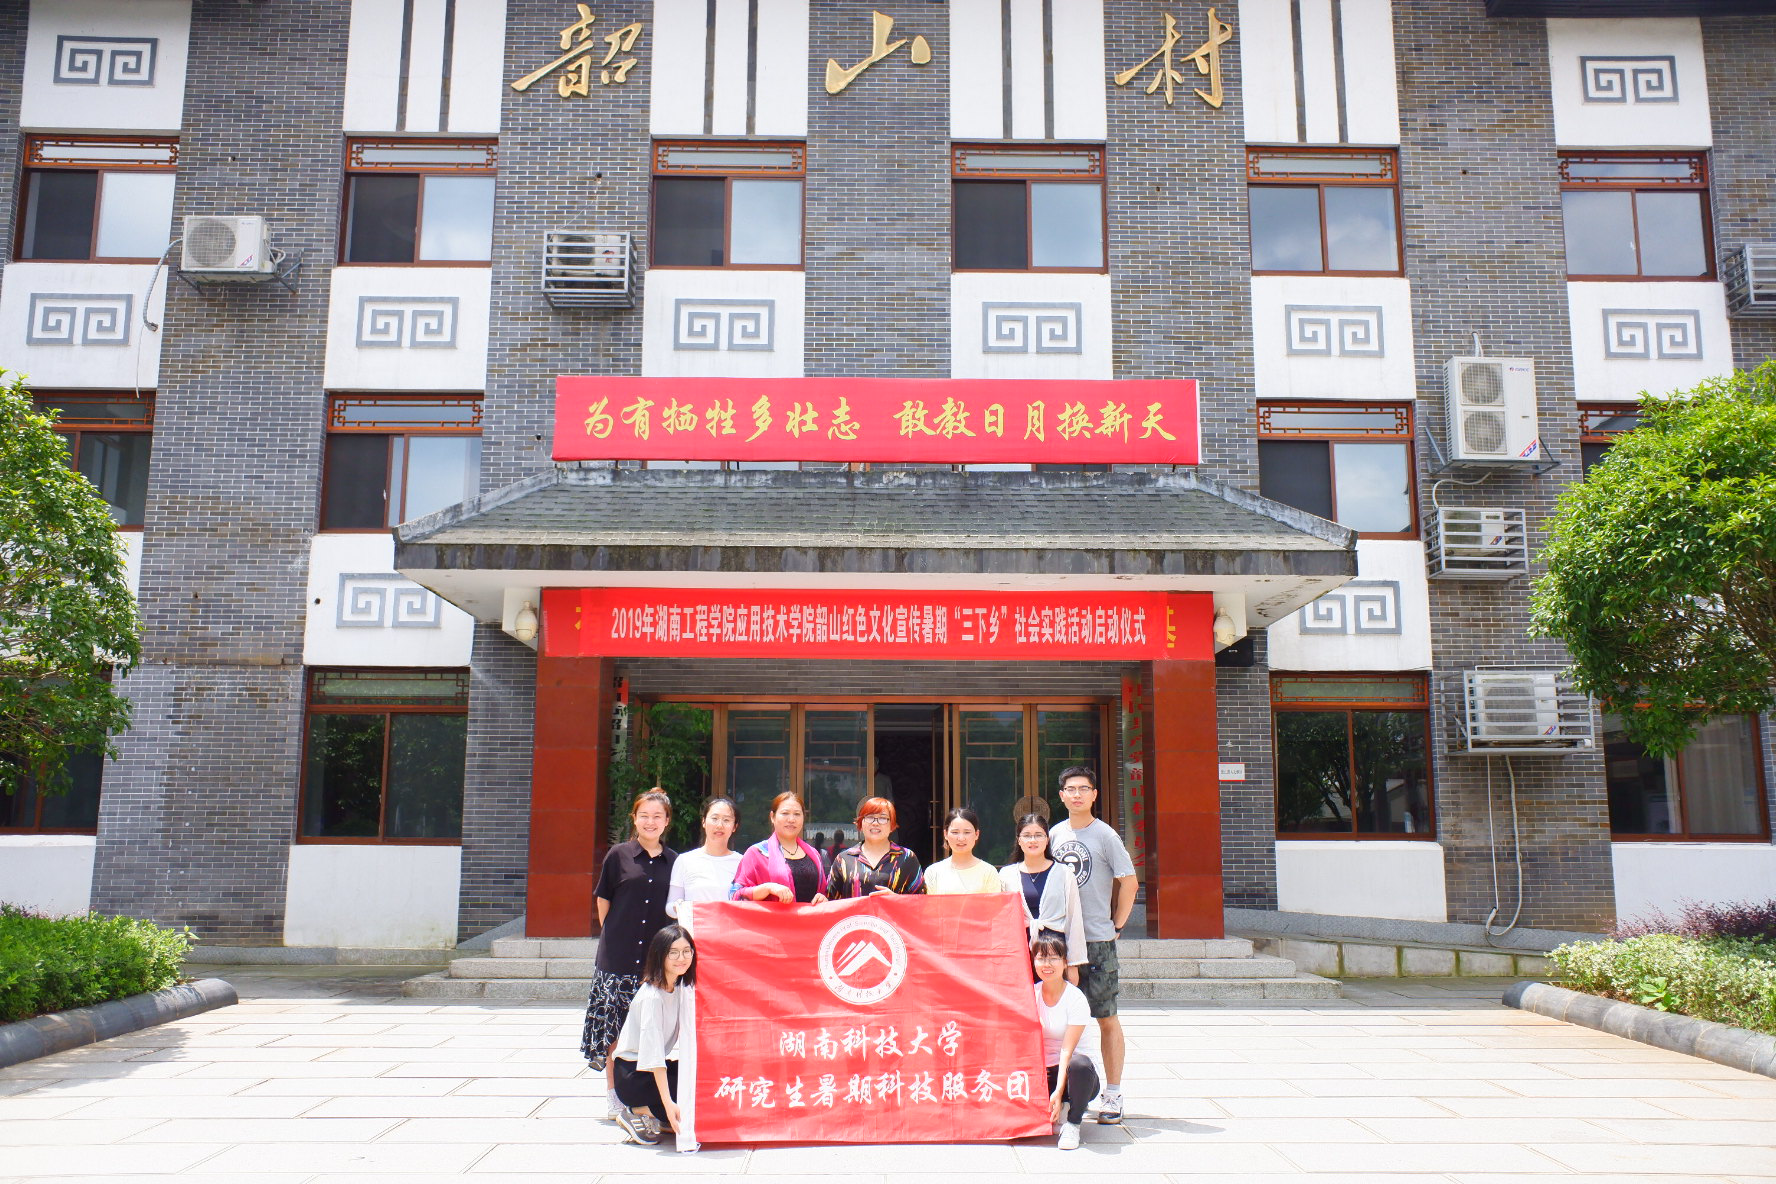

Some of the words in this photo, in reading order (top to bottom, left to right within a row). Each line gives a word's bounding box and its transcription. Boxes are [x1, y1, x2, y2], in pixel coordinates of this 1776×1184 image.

[511, 4, 1232, 108] 韶山村
[584, 394, 861, 443] 为有牺牲多壮志
[893, 396, 1177, 444] 敢教日月换新天
[779, 1021, 962, 1061] 湖南科技大学
[714, 1069, 1030, 1110] 研究生暑期科技服务团
